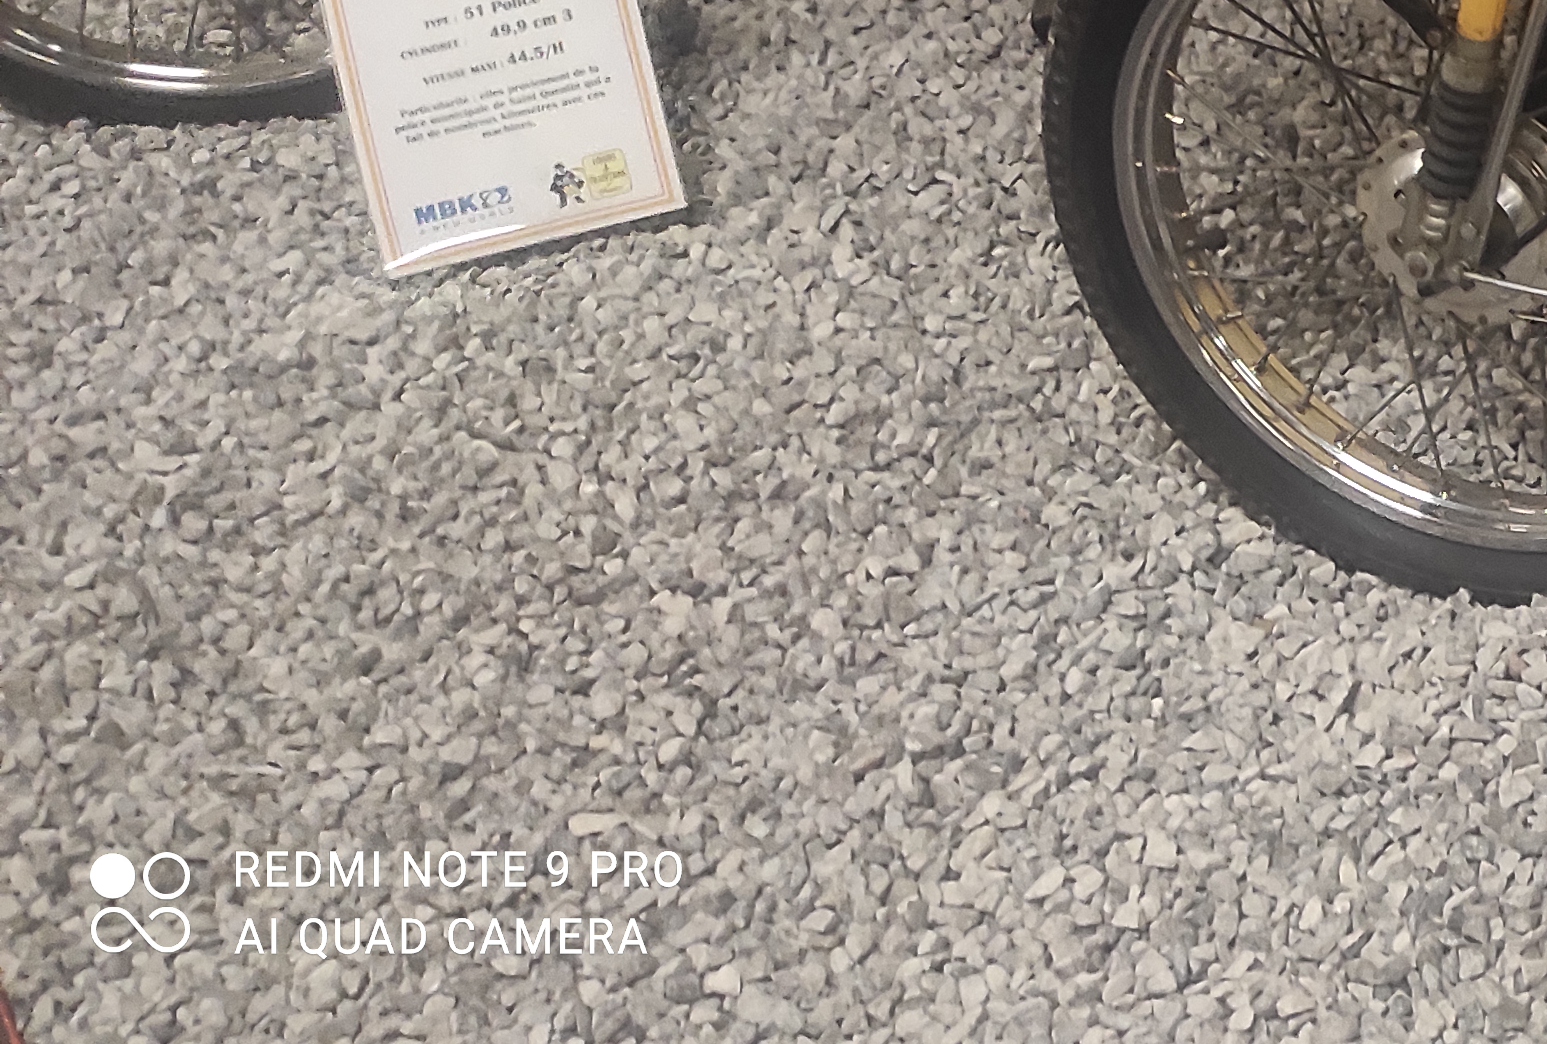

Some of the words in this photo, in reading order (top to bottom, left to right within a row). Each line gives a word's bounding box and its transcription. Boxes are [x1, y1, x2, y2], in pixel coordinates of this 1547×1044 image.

[463, 4, 484, 20] 51
[490, 18, 527, 39] 49,9
[533, 14, 558, 29] cm
[562, 8, 573, 23] 3
[413, 191, 479, 226] MBK
